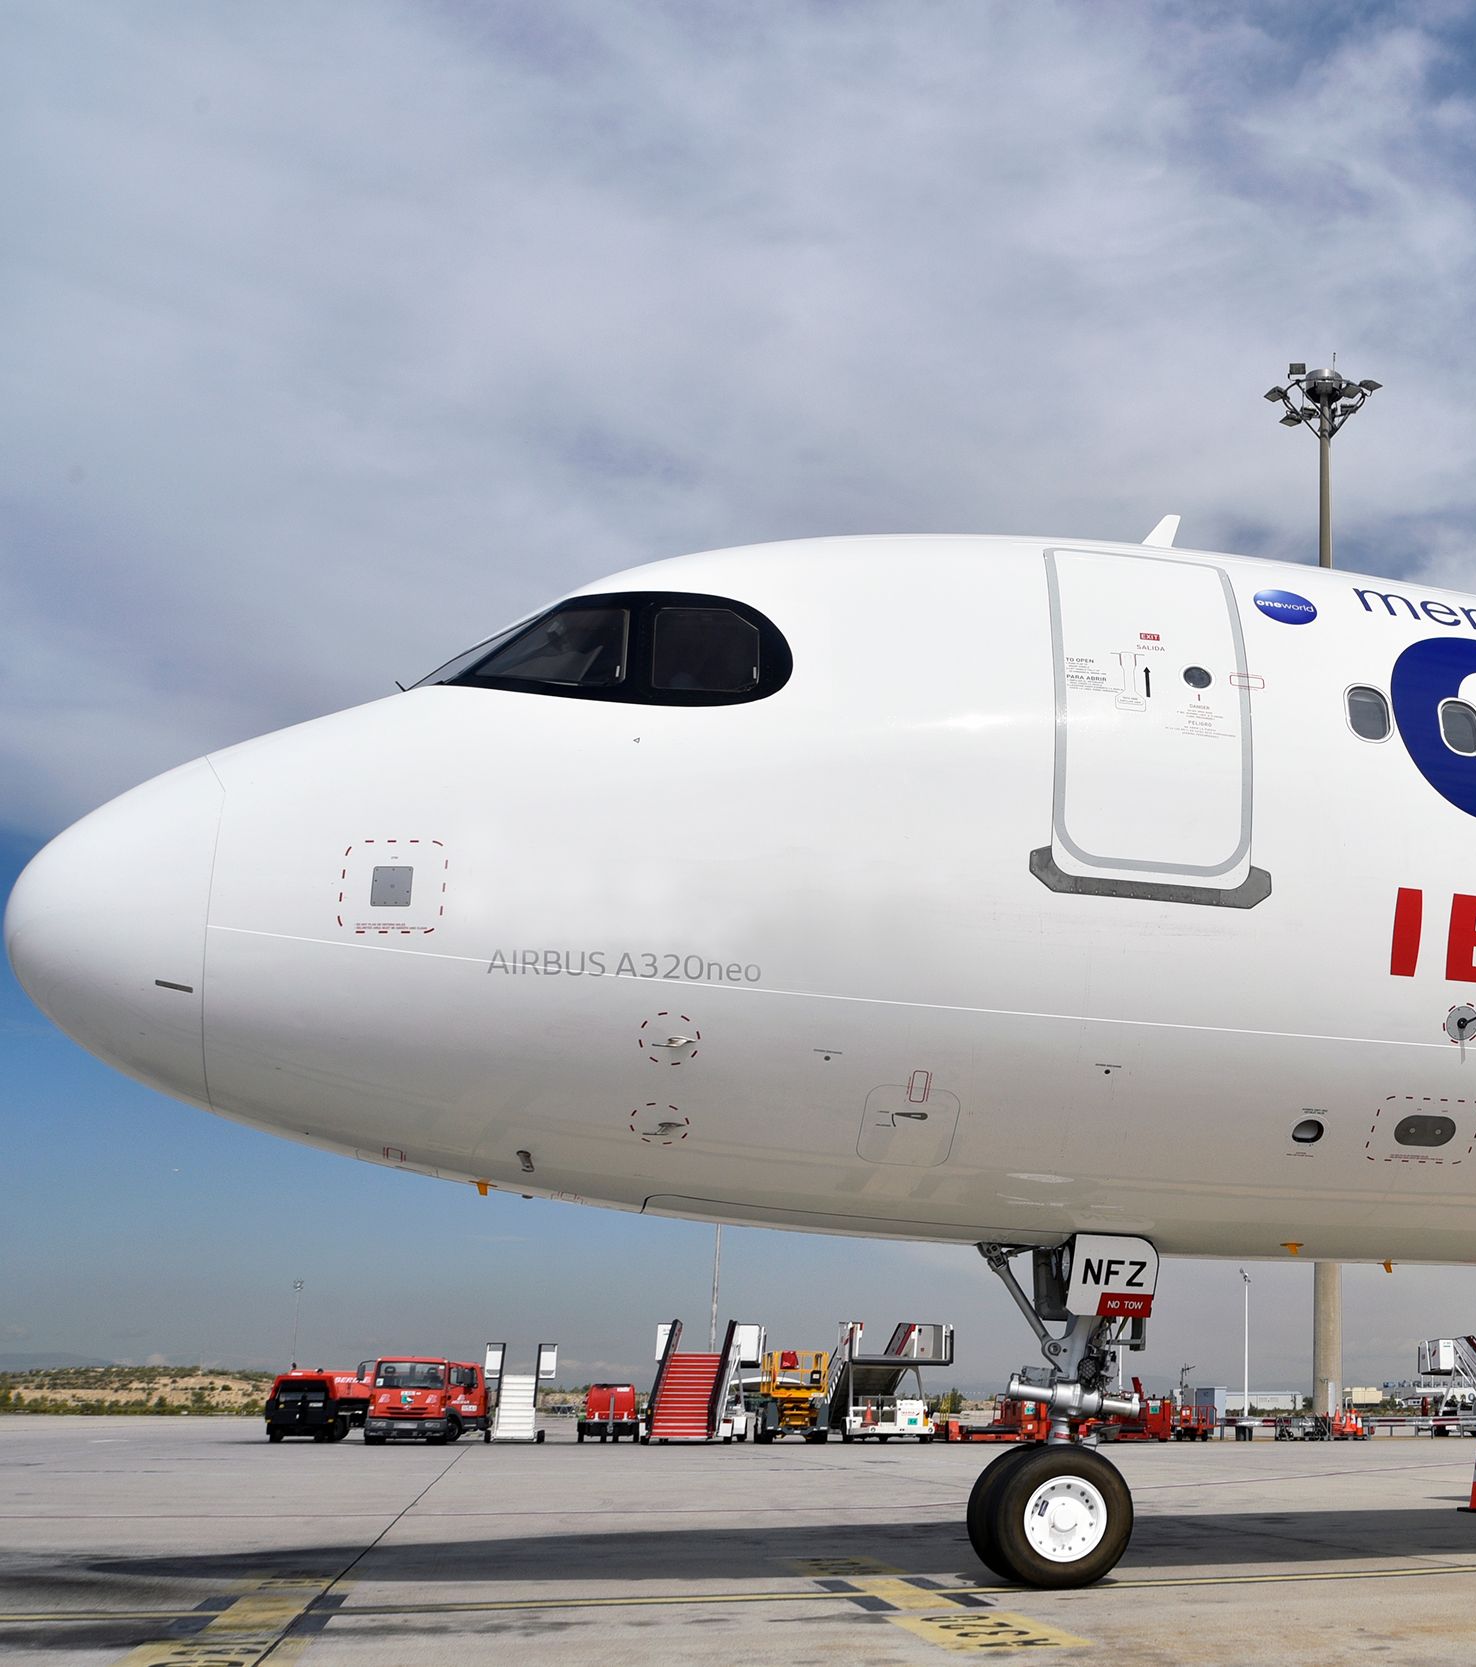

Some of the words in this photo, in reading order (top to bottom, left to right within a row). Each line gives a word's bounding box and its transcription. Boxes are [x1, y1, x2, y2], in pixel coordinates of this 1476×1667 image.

[1256, 599, 1314, 613] oneworld
[1141, 633, 1160, 641] EXIT
[1136, 644, 1166, 652] SALIDA
[1188, 720, 1213, 728] PELIGRO
[487, 949, 606, 977] AIRBUS
[615, 952, 762, 982] A320neo
[1082, 1258, 1147, 1288] NFZ
[1107, 1301, 1120, 1309] NO
[1124, 1301, 1143, 1310] TOW
